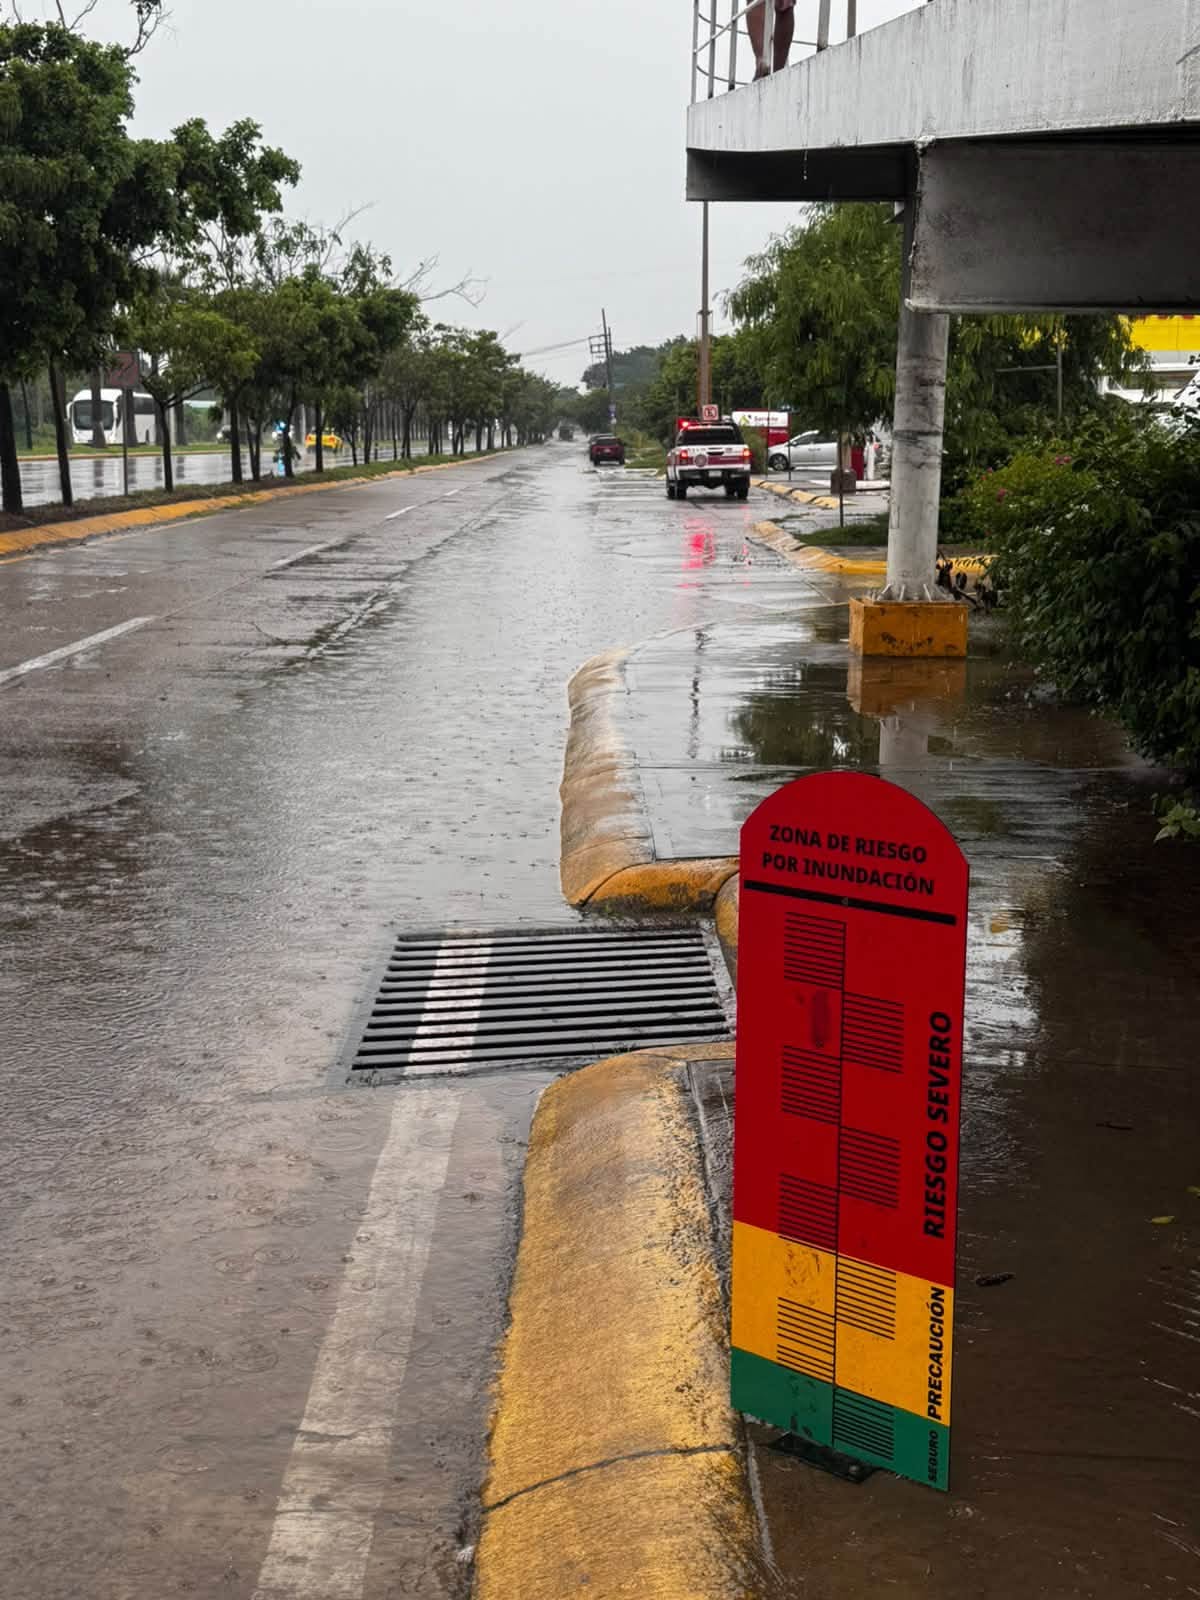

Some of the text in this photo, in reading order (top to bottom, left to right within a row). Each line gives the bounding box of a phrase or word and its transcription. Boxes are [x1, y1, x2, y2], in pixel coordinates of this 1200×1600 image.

[769, 824, 927, 864] ZONA DE RIESGO
[762, 852, 934, 895] POR INUNDACIÓN
[923, 1011, 952, 1239] RIESGO SEVERO
[926, 1286, 945, 1421] PRECAUCIÓN
[928, 1430, 939, 1482] SEGURO
